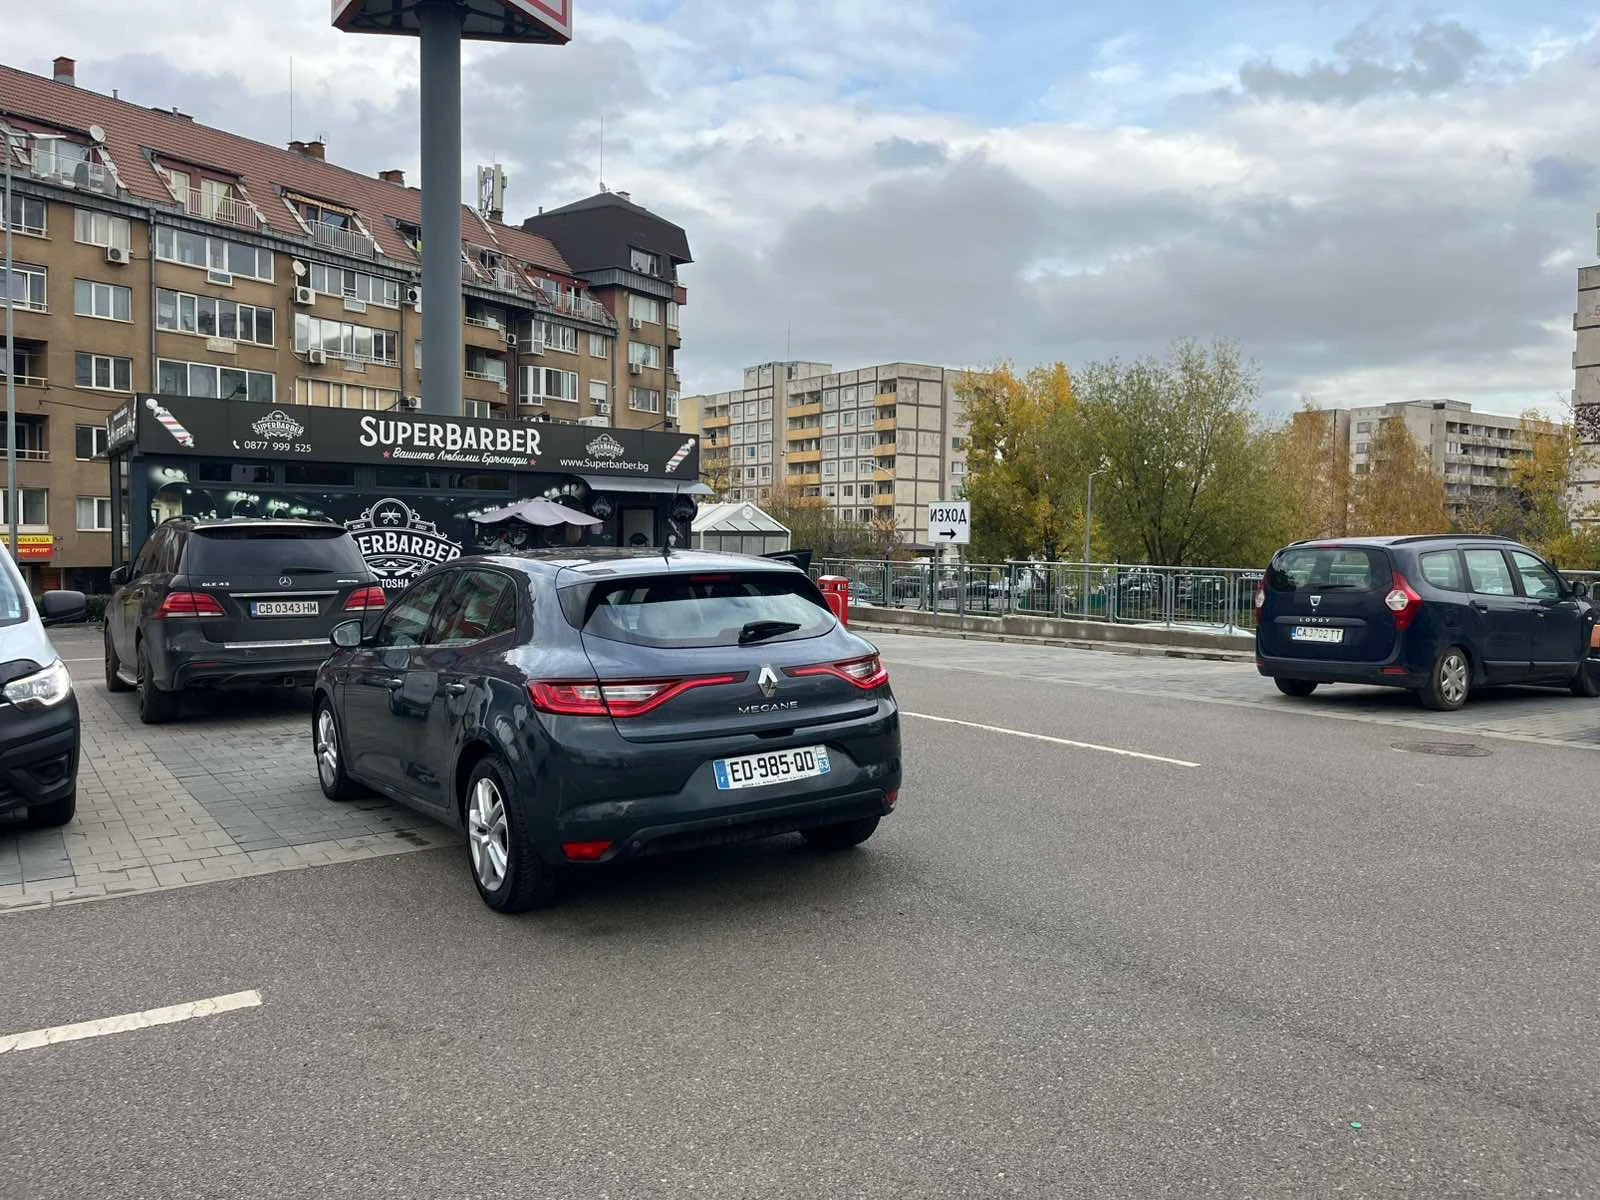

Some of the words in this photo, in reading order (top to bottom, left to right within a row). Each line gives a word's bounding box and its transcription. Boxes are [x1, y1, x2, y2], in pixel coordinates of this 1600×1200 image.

[252, 421, 305, 435] SUPERBARBER
[359, 416, 542, 455] SUPERBARBER
[244, 440, 268, 450] 0877
[272, 442, 291, 452] 999
[294, 443, 312, 453] 525
[392, 447, 436, 460] Вашите
[436, 450, 480, 463] Любими
[481, 452, 528, 467] Бръснари
[559, 457, 650, 473] www.Superbarber.bg
[930, 508, 967, 525] ИЗХОД
[738, 700, 799, 714] MEGANE
[729, 750, 816, 782] ED-985-QD
